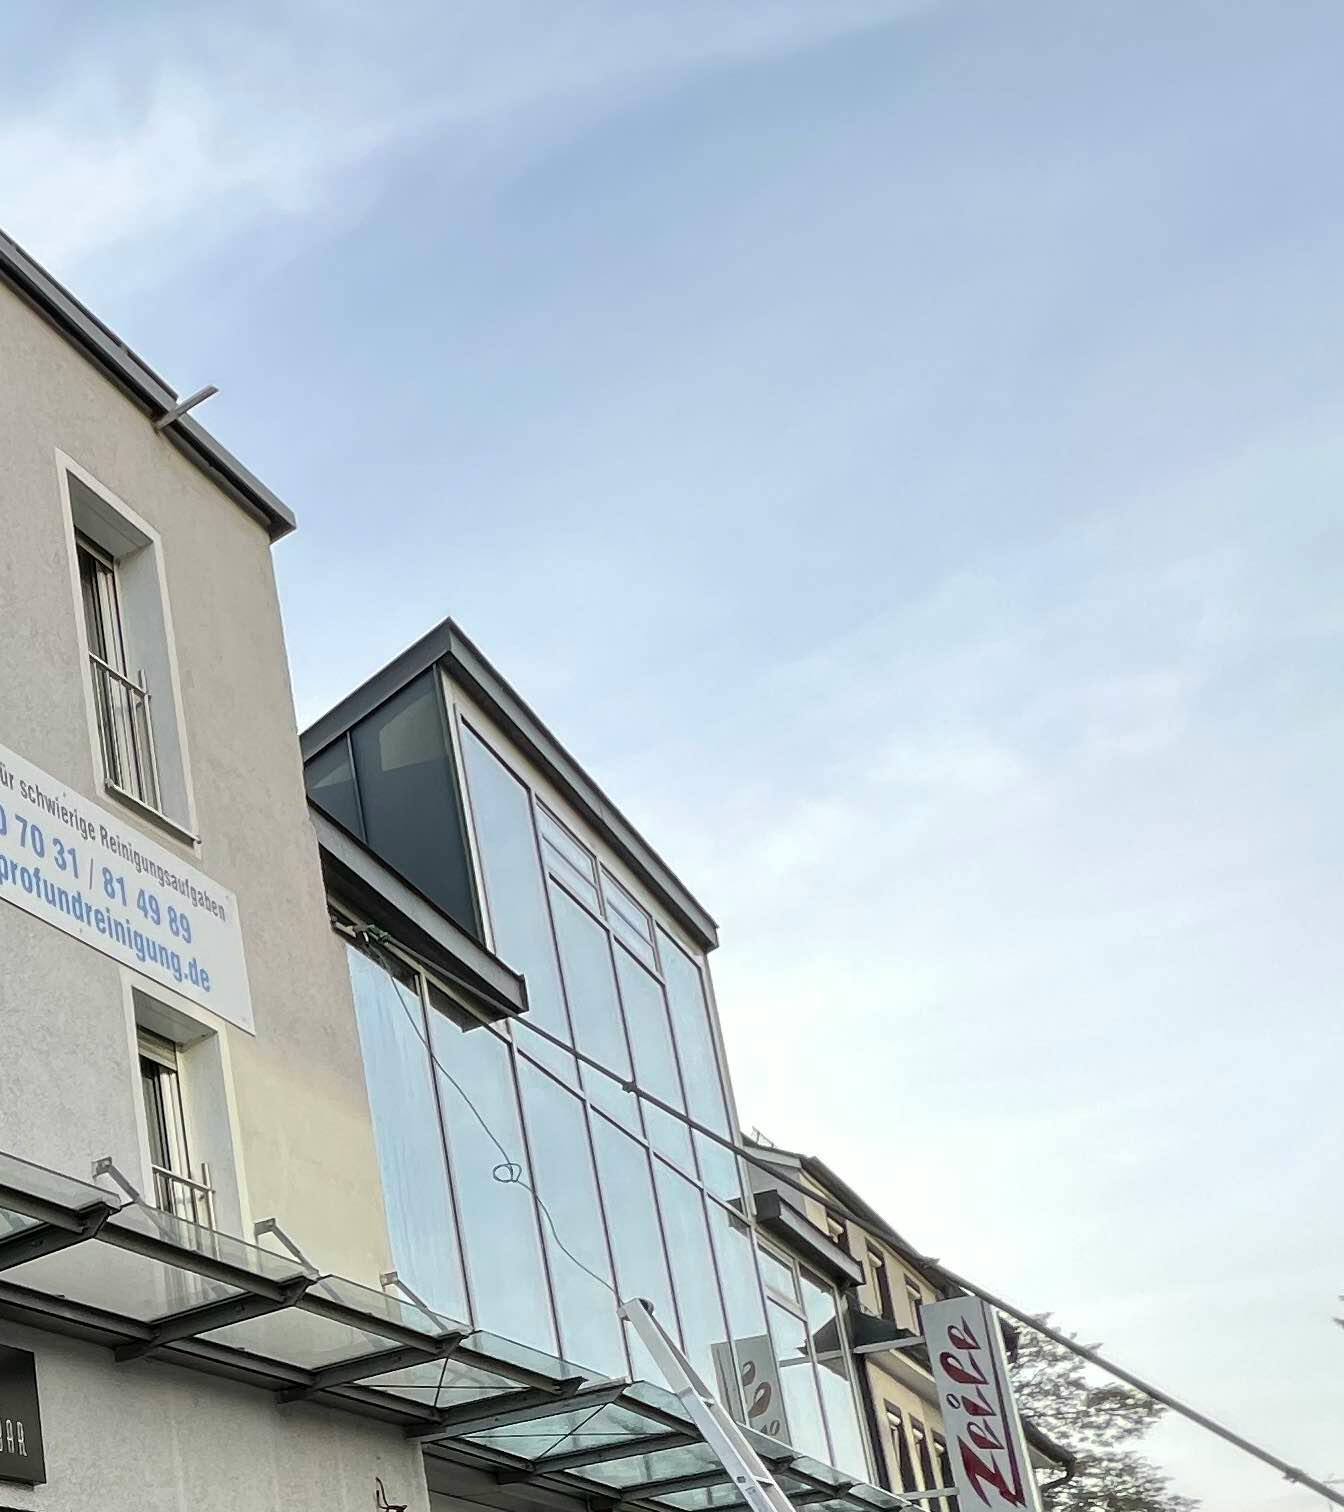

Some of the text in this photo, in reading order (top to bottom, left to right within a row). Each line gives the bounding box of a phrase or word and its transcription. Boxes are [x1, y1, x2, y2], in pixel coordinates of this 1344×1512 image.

[14, 813, 46, 859] 70
[51, 837, 79, 880] 31
[88, 857, 94, 891] /
[101, 866, 127, 907] 81
[136, 888, 162, 926] 49
[167, 904, 193, 944] 89
[19, 779, 96, 841] schwierige
[99, 824, 226, 922] Reinigungsaufgaben
[940, 1315, 1027, 1508] Zeile
